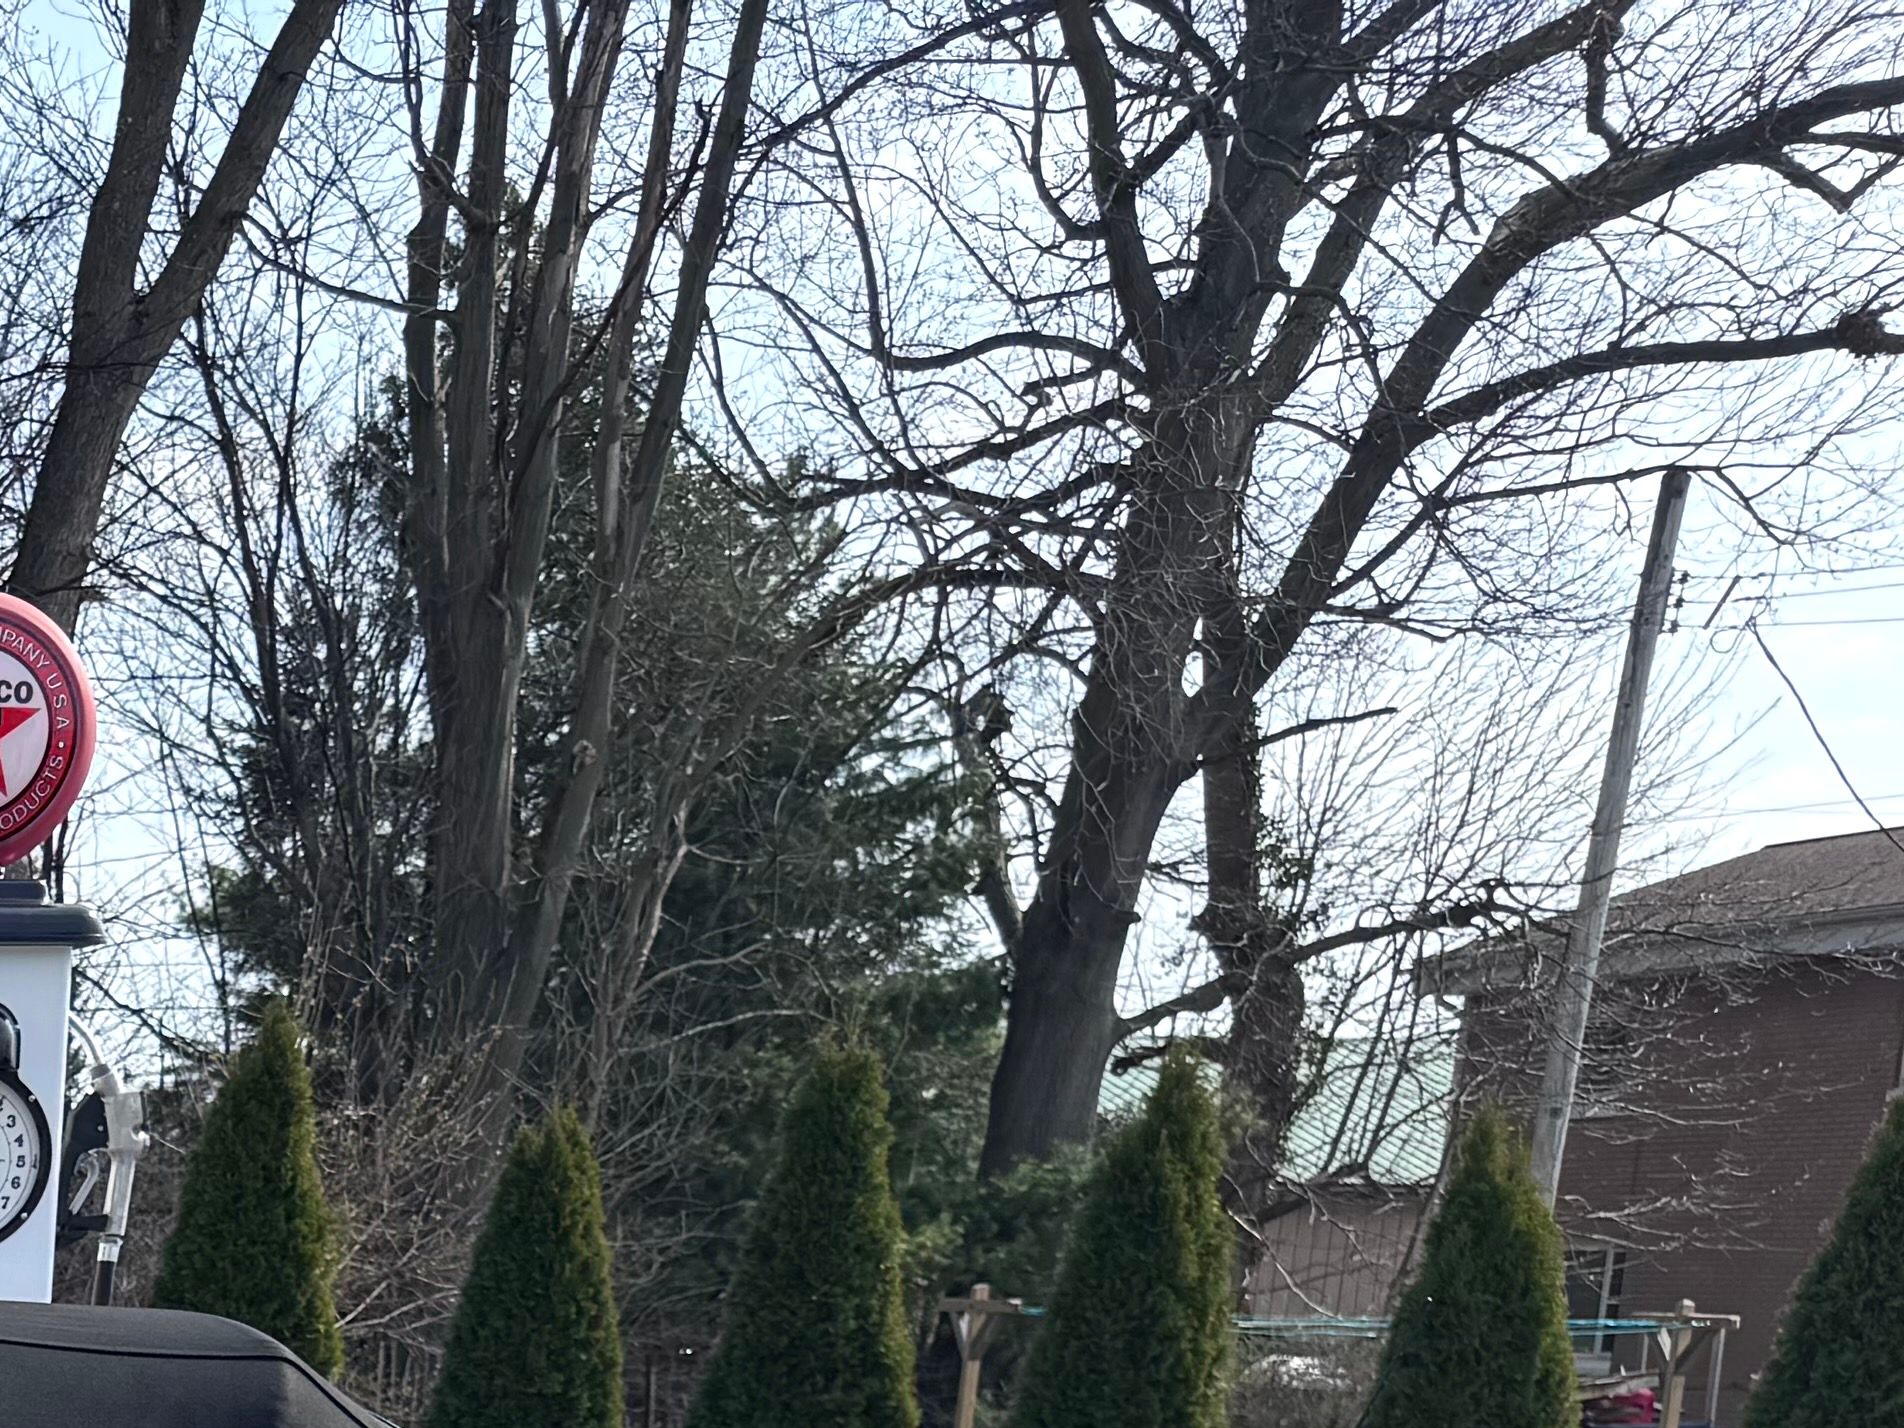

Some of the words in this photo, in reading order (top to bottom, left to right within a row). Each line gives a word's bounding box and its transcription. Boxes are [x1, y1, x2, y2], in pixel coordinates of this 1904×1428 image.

[7, 1115, 16, 1128] 3
[14, 1134, 24, 1147] 4
[16, 1156, 26, 1168] 5
[11, 1176, 21, 1189] 6
[1, 1196, 10, 1210] 7
